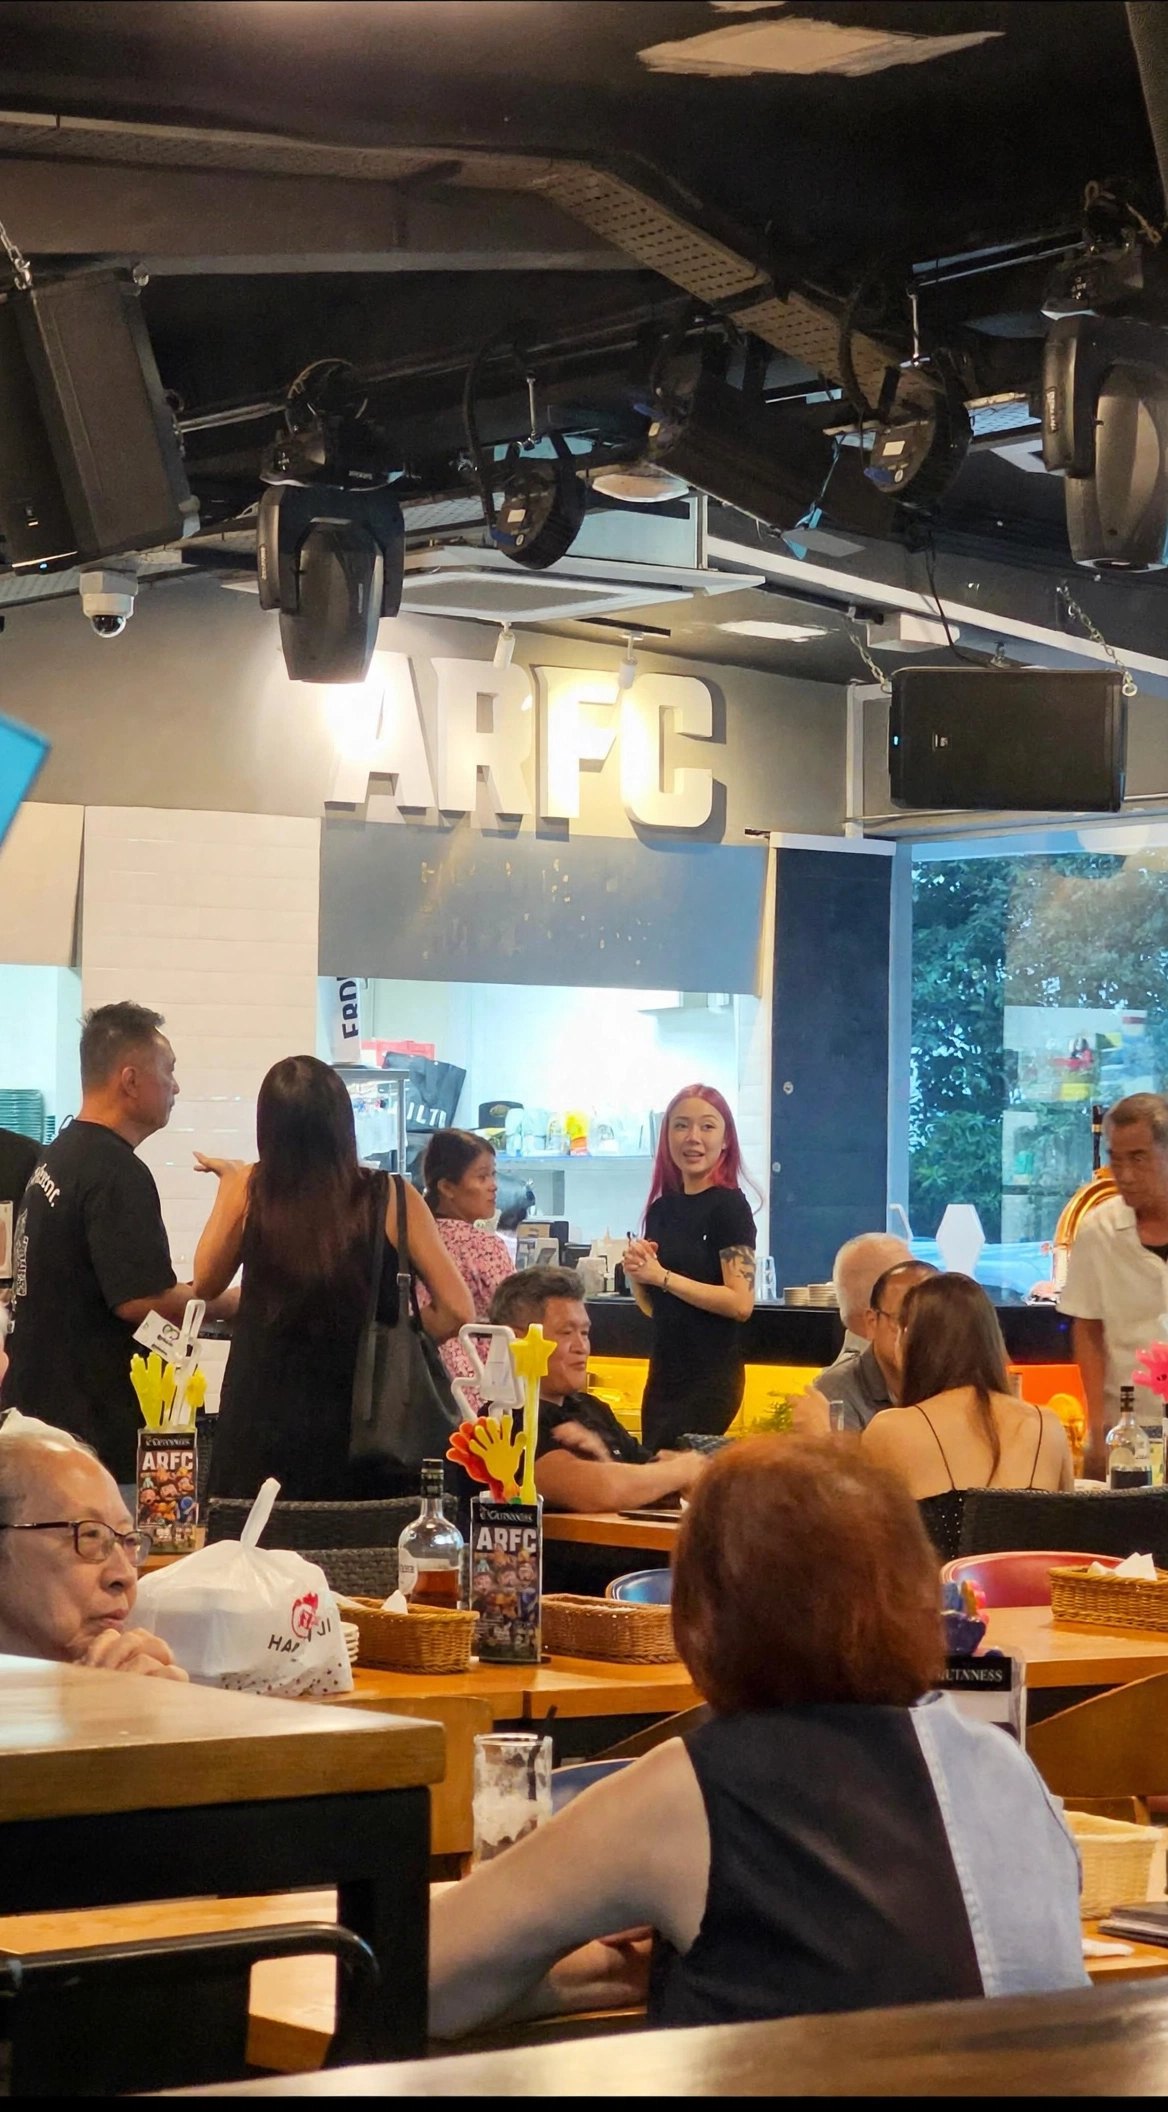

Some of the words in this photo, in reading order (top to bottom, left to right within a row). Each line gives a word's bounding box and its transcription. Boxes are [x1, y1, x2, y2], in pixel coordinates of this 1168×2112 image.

[325, 650, 713, 828] ARFC
[142, 1451, 194, 1471] ARFC
[476, 1526, 537, 1553] ARFC
[940, 1669, 1003, 1683] UINNESS
